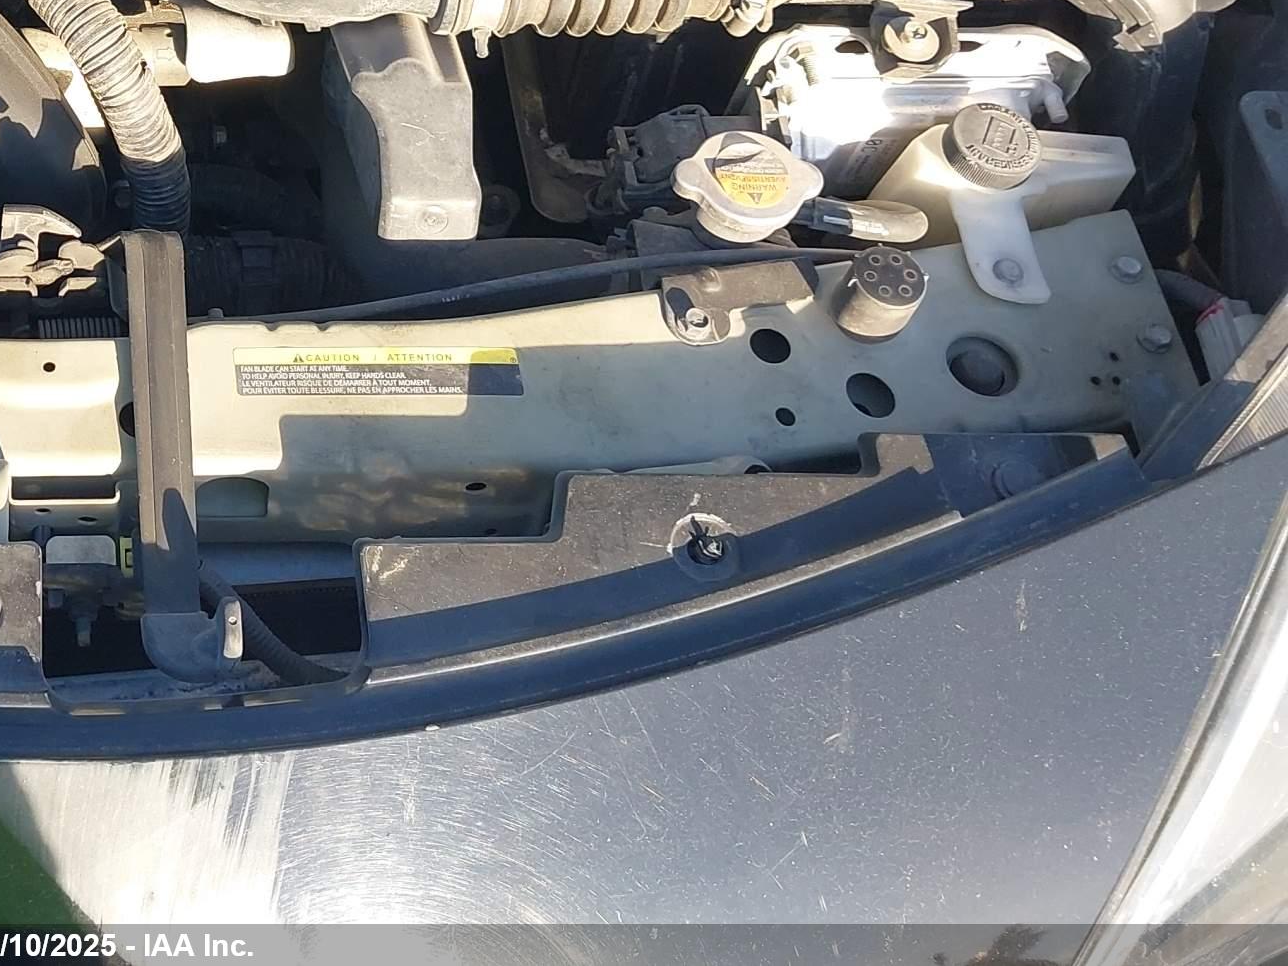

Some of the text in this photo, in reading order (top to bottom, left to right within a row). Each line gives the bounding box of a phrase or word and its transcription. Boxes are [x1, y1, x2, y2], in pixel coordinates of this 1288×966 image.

[731, 182, 777, 191] WARNING
[305, 354, 361, 363] CAUTION
[387, 353, 453, 362] ATTENTION
[242, 372, 251, 380] TO
[252, 372, 268, 380] HELP
[268, 372, 288, 380] AVOID
[289, 372, 322, 380] PERSONAL
[345, 372, 361, 380] KEEP
[362, 372, 384, 380] HANDS
[242, 379, 251, 387] LE
[251, 379, 297, 387] VENTILATEUR
[297, 379, 323, 387] RISQUE
[323, 379, 333, 387] DE
[379, 379, 398, 387] TOUT
[243, 386, 263, 394] POUR
[288, 386, 311, 394] TOUTE
[347, 386, 357, 394] NE
[358, 386, 371, 394] PAS
[372, 386, 381, 394] EN
[382, 386, 425, 394] APPROCHER
[425, 386, 437, 394] LES
